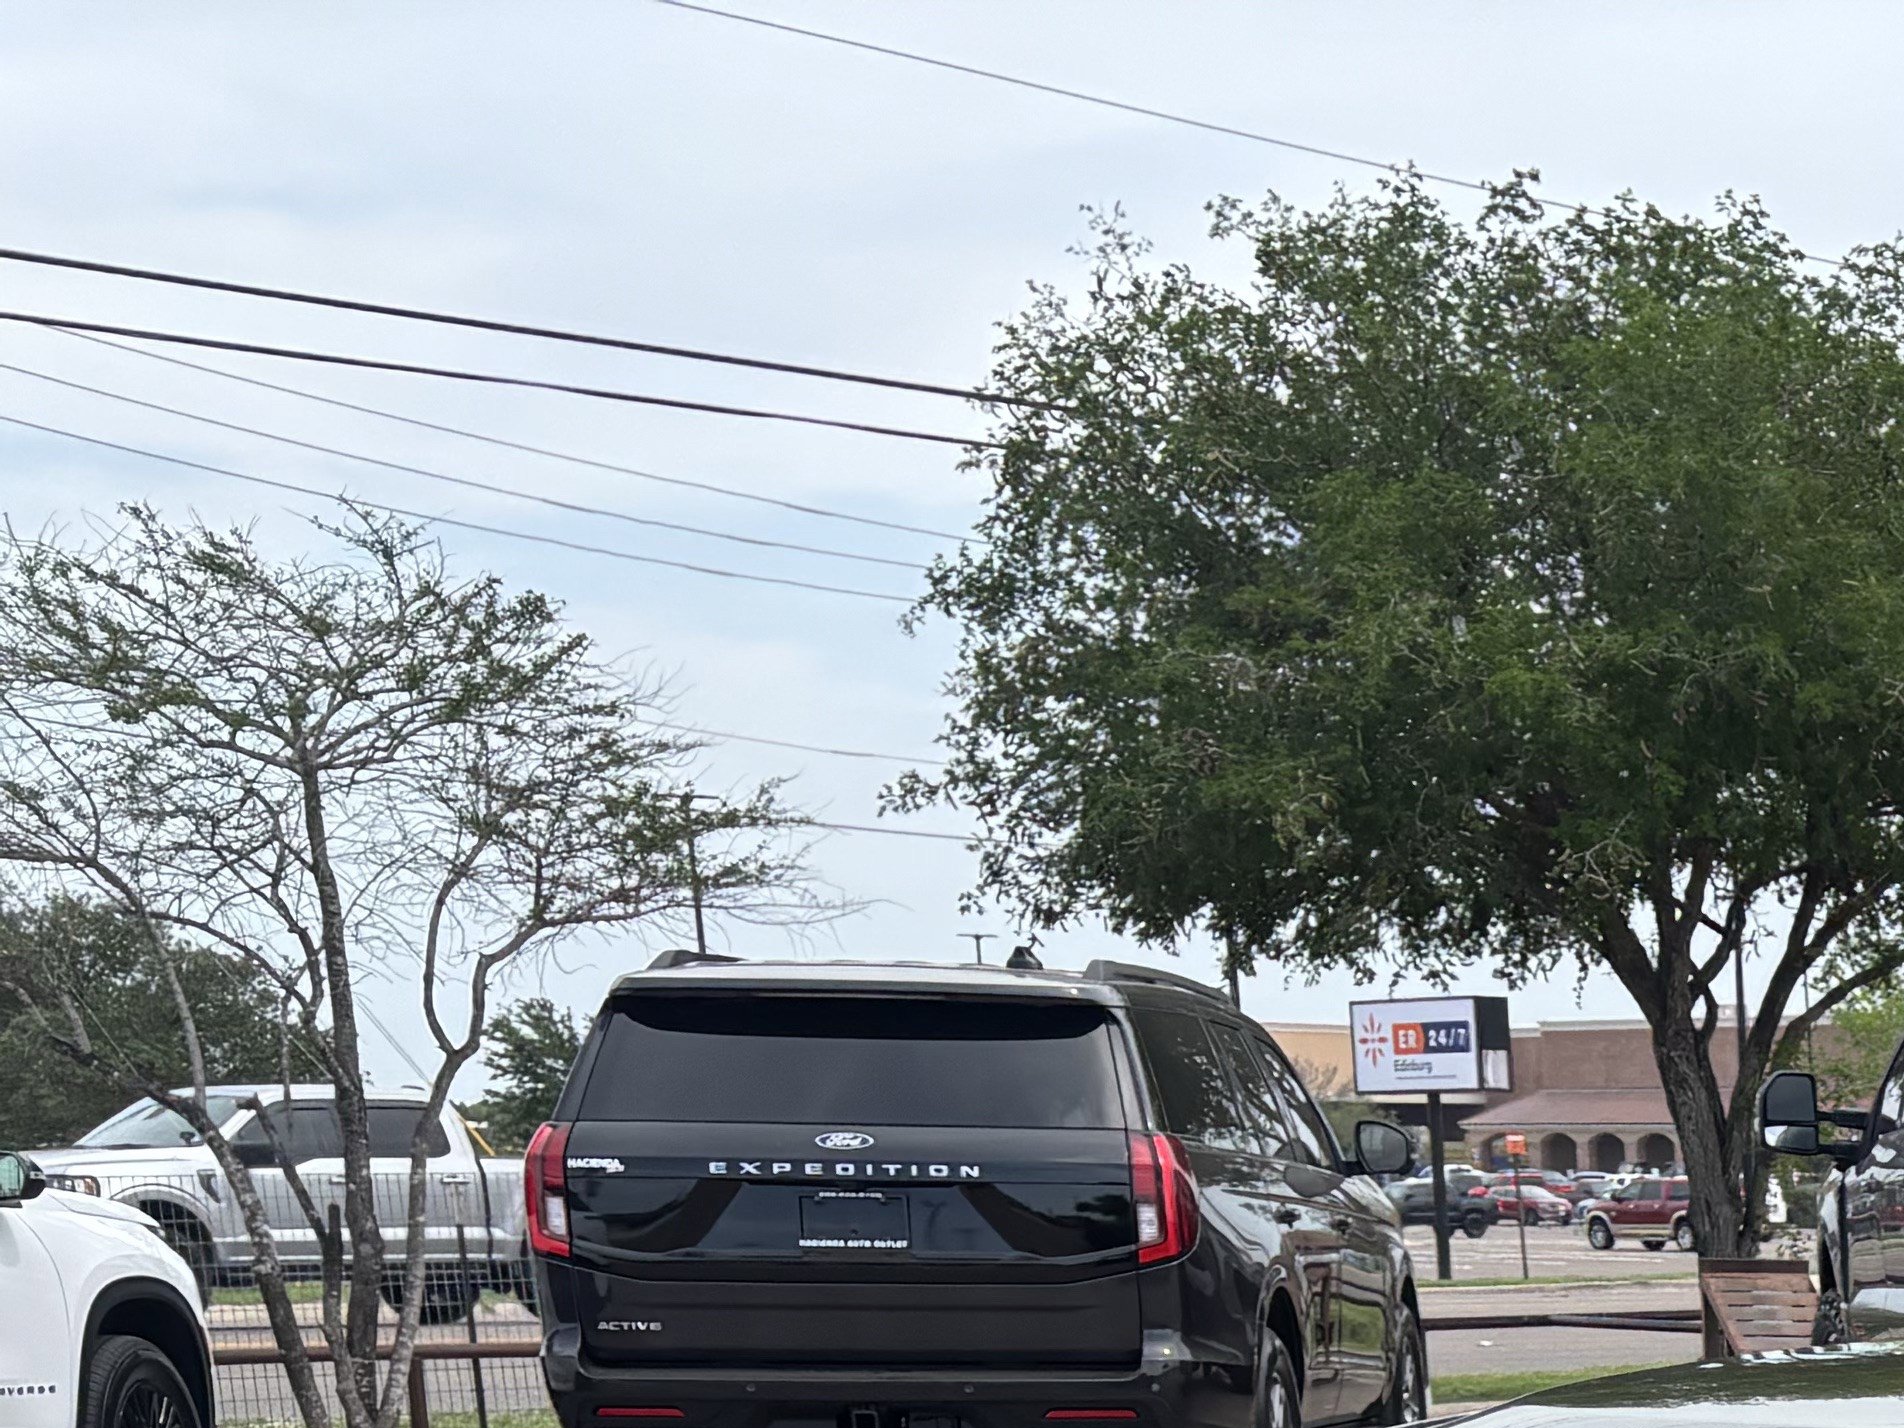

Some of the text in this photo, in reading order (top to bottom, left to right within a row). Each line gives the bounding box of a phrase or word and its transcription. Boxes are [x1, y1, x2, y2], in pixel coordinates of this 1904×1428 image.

[1398, 1028, 1467, 1049] ER 24/7
[708, 1161, 980, 1178] EXPEDITION
[597, 1321, 662, 1331] ACTIVE
